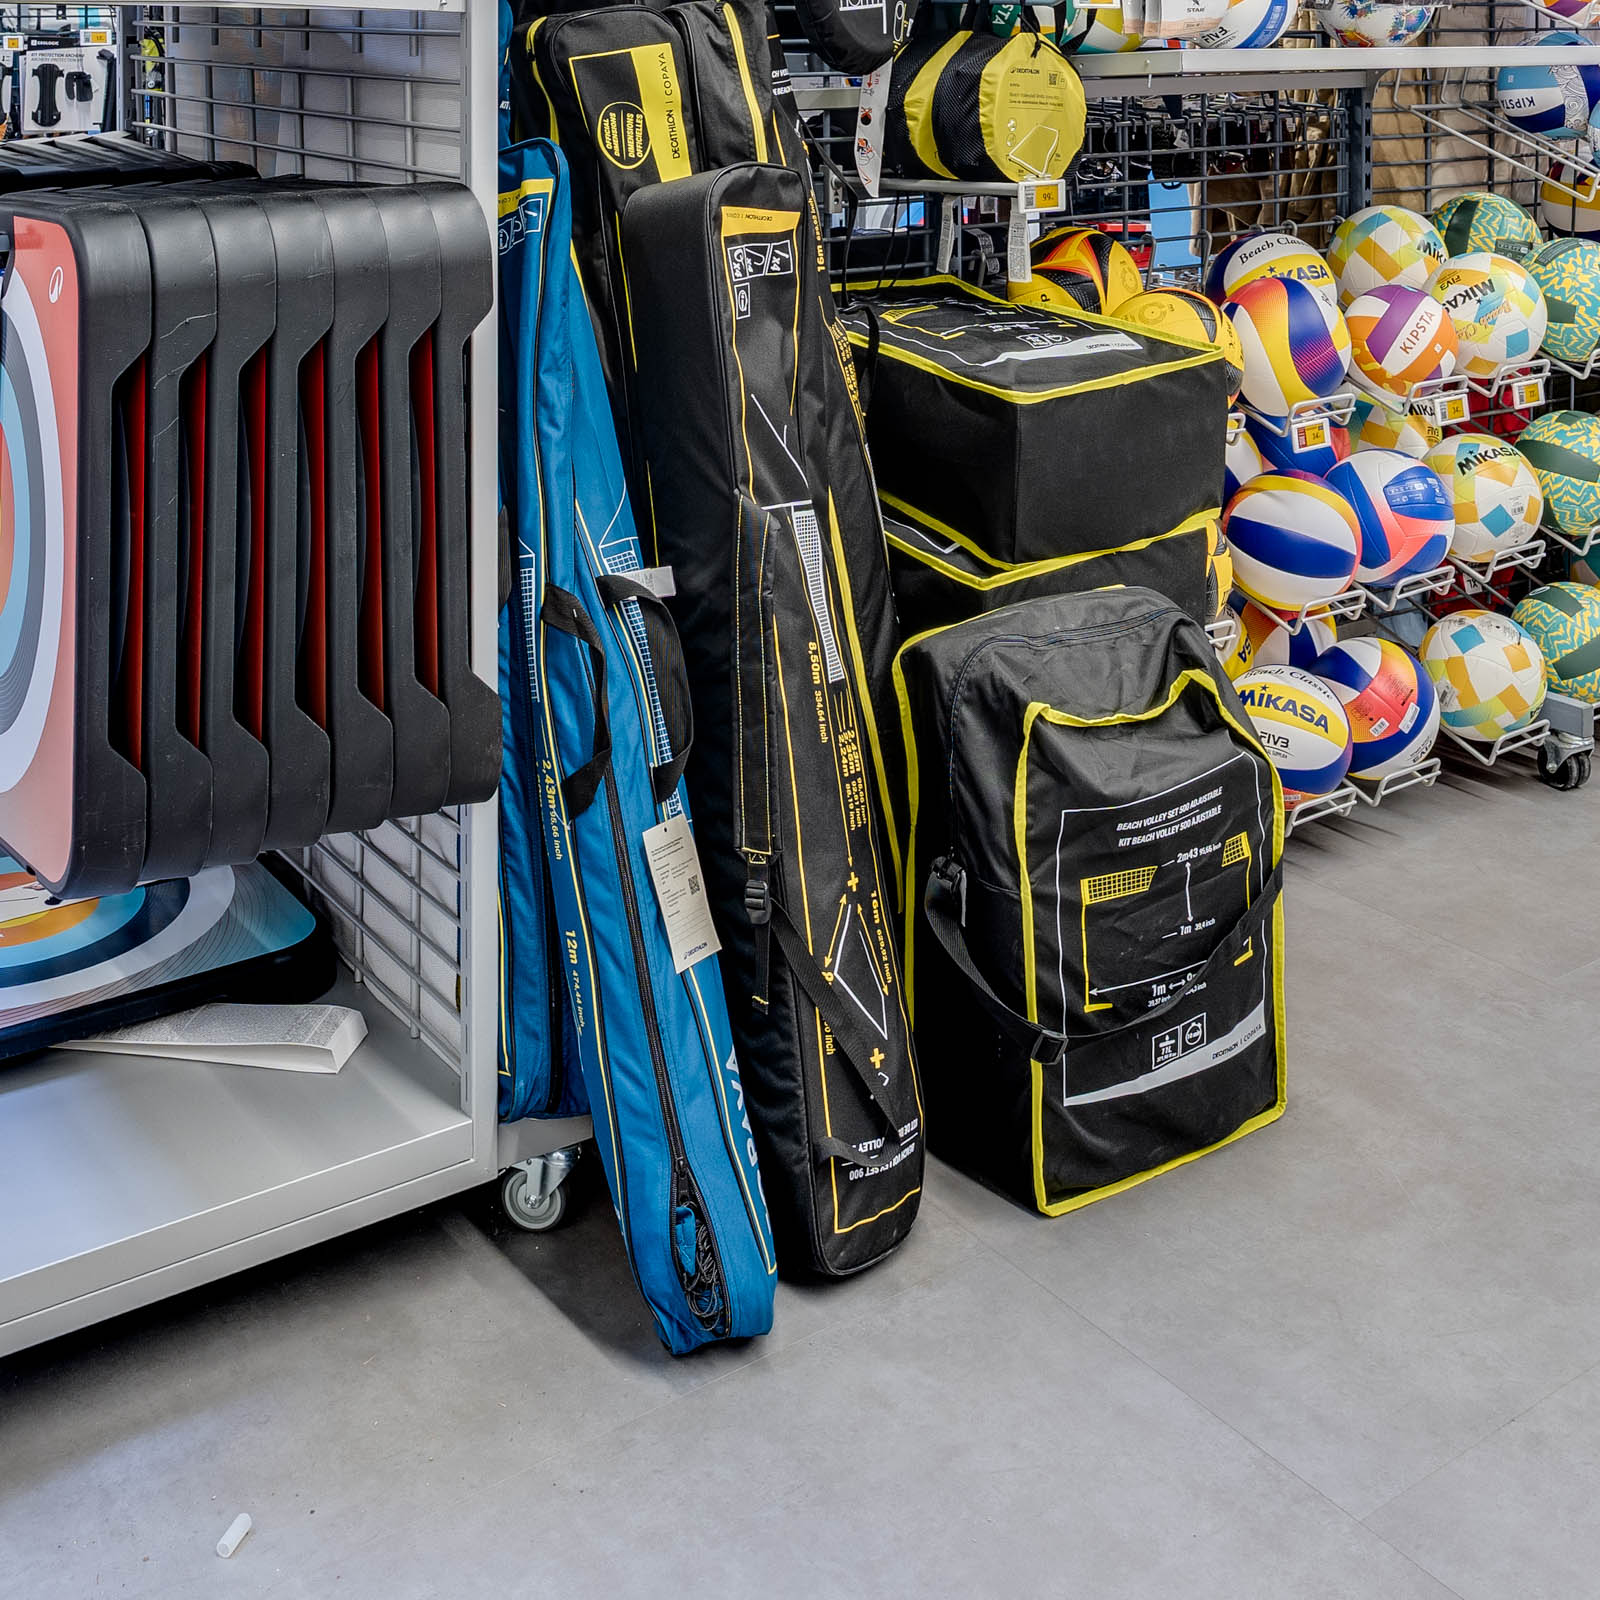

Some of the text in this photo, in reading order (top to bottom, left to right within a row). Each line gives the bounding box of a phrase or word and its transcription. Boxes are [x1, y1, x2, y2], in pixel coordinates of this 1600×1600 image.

[658, 52, 673, 96] COPAYA
[1501, 96, 1536, 110] KIPST
[603, 118, 613, 150] OFFICIAL
[609, 112, 621, 158] DIMENSIONS
[626, 112, 636, 159] DIMENSIONS
[635, 113, 644, 158] OFFICIELLES
[666, 109, 681, 160] DECATHLON
[816, 245, 826, 272] 16m
[1239, 239, 1275, 265] Beach
[1417, 239, 1447, 265] MIK
[1443, 278, 1496, 313] MIKAS
[1399, 310, 1435, 355] KIPSTA
[1403, 399, 1436, 417] MIKA
[1457, 446, 1520, 476] MIKASA
[807, 641, 822, 685] 8,50m
[818, 725, 828, 744] inch
[1289, 670, 1334, 699] Classic
[1236, 685, 1329, 734] MIKASA
[542, 758, 563, 860] 2,43m inch
[849, 812, 857, 831] inch
[1116, 786, 1223, 832] BEACH VOLLEY SET 500 ADJUSTABLE
[1118, 804, 1222, 848] KIT BEACH VOLLEY 500 AJUSTABLE
[1177, 846, 1199, 864] 2m43
[1211, 841, 1222, 853] inch
[870, 890, 893, 984] 16m inch
[1180, 923, 1192, 936] 1m
[1204, 917, 1216, 929] inch
[565, 930, 578, 965] 12m
[1151, 983, 1166, 999] 1m
[826, 1032, 836, 1056] inch
[1243, 1023, 1262, 1041] COPAYA
[1211, 1041, 1238, 1061] DECATHLON
[849, 1167, 864, 1181] 900
